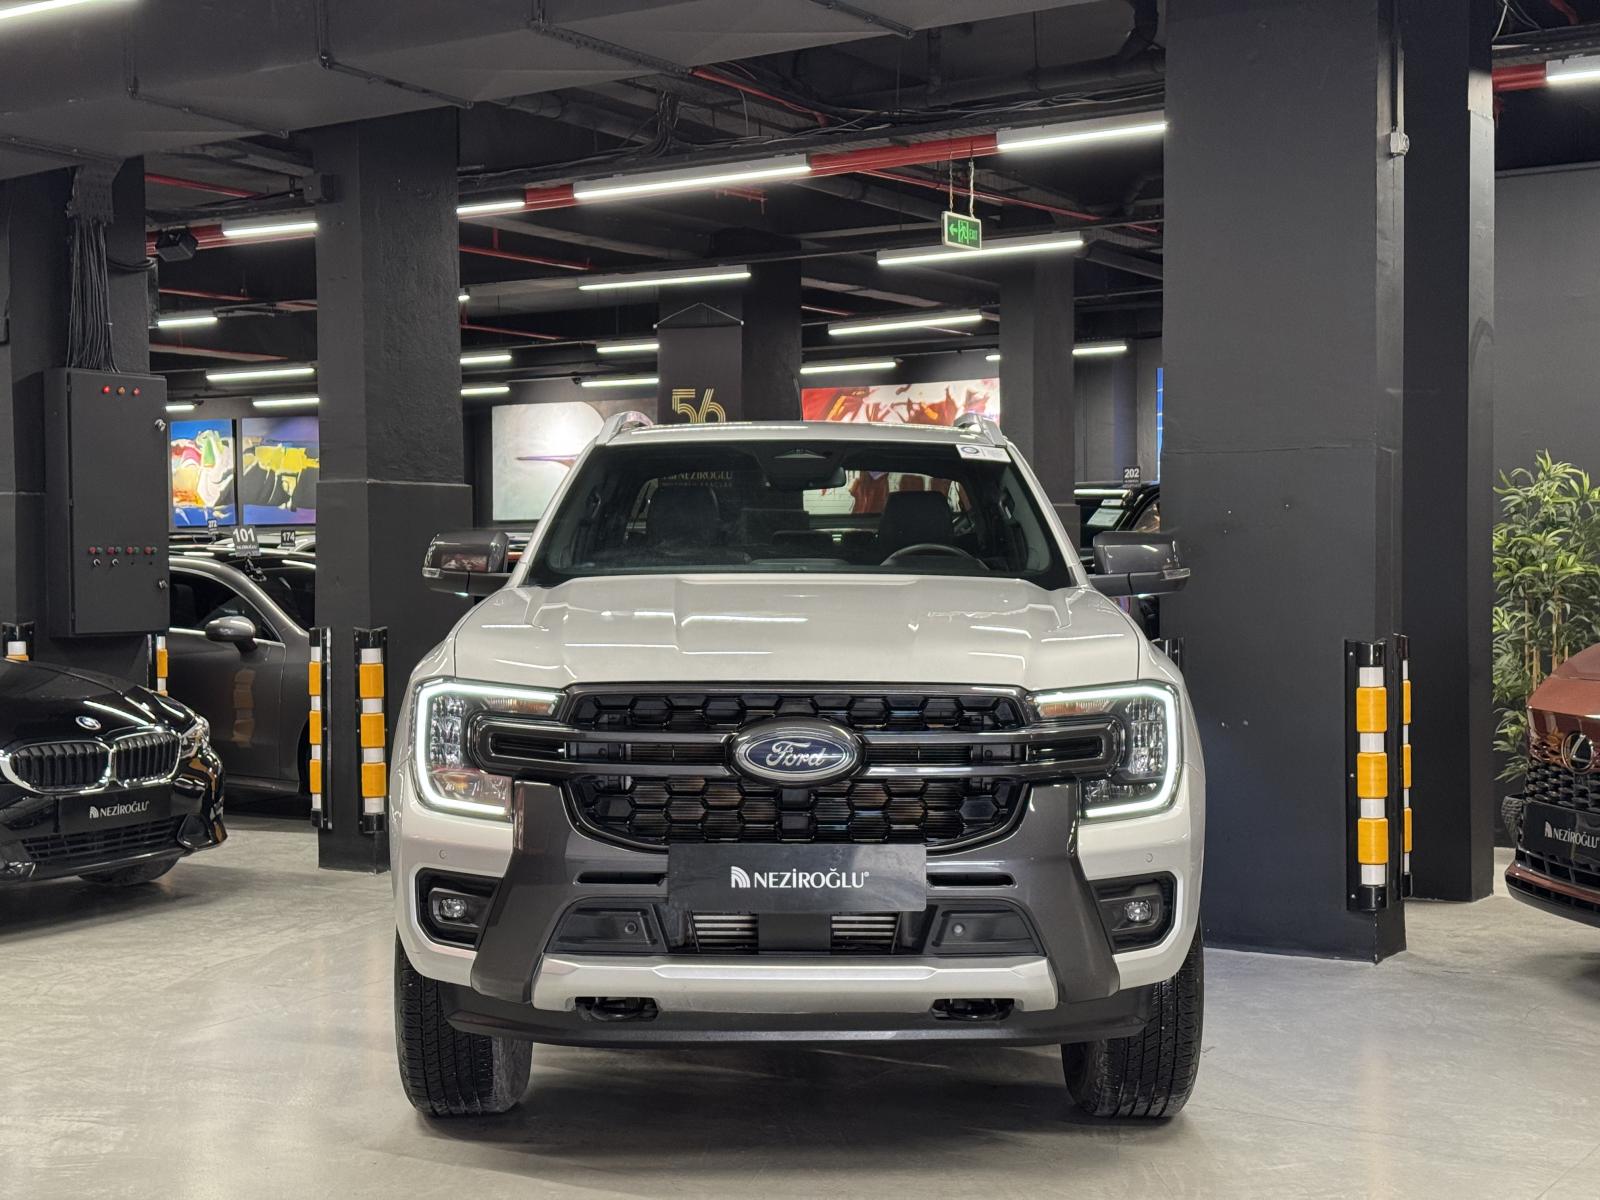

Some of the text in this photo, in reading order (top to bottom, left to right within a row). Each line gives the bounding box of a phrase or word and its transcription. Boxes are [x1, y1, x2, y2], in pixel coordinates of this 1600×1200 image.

[671, 388, 726, 424] 56
[1124, 468, 1140, 478] 202
[232, 528, 255, 543] 101
[282, 532, 295, 542] 174
[765, 740, 828, 767] Ford
[100, 800, 148, 817] NEZİROĞLU
[1553, 827, 1597, 849] NEZİROĞLU
[754, 868, 865, 889] NEZİROĞLU
